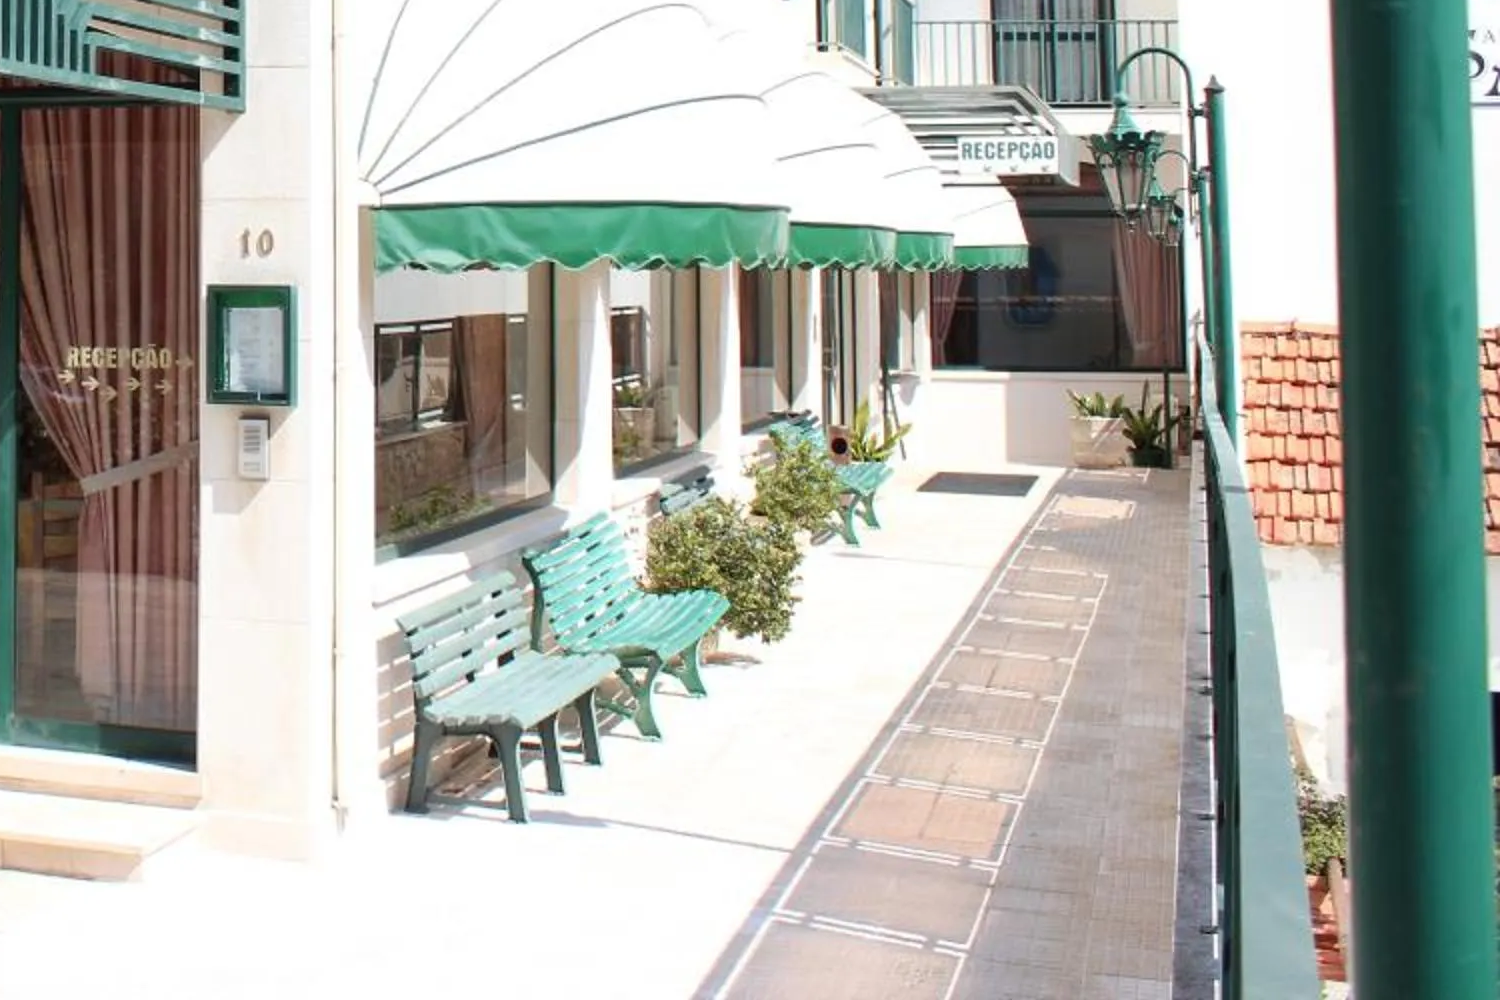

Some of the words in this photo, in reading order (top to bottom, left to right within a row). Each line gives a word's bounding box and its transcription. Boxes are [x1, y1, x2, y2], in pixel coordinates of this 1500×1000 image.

[961, 138, 1055, 163] RECEPÇÃO
[240, 228, 275, 259] 10
[67, 343, 172, 370] RECEPÇÃO
